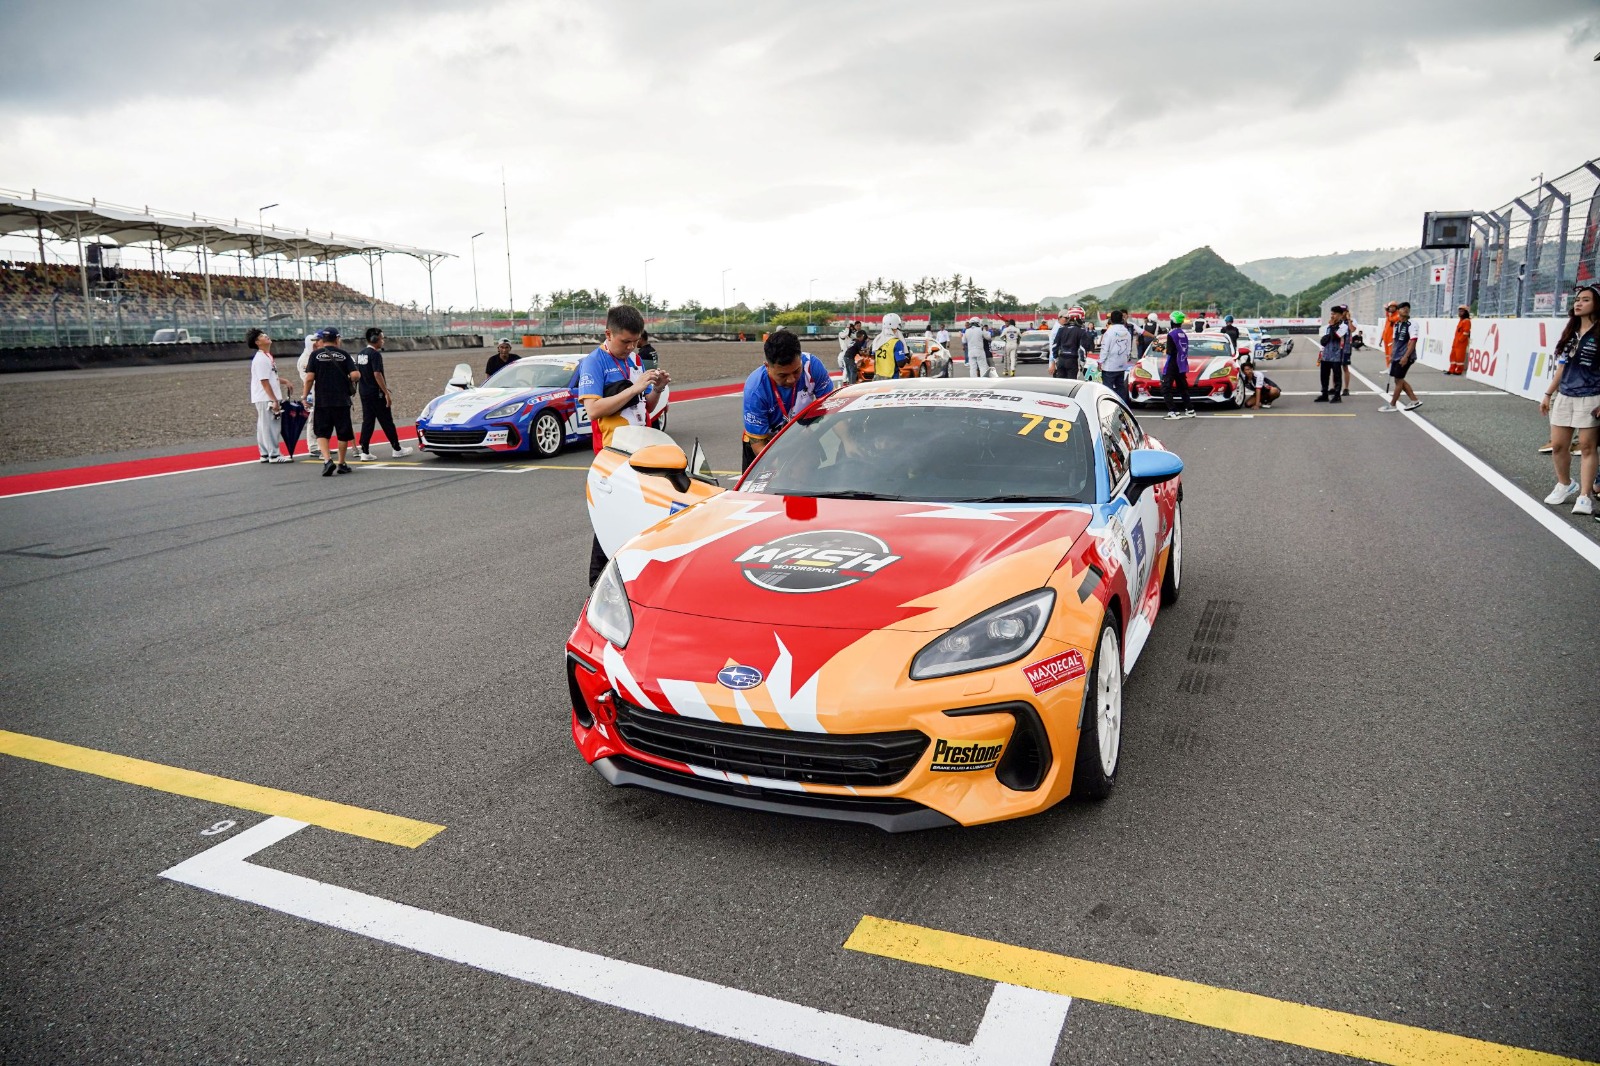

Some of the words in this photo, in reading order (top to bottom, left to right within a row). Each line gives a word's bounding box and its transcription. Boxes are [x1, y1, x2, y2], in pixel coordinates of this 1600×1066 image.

[876, 348, 887, 360] 23
[865, 391, 940, 401] FESTIVAL
[968, 393, 1023, 402] SPEED
[1017, 413, 1072, 443] 78
[733, 545, 902, 573] WISH
[772, 564, 838, 574] MOTORSPORT
[1027, 654, 1080, 682] MAXDECAL
[932, 738, 1003, 763] Prestone
